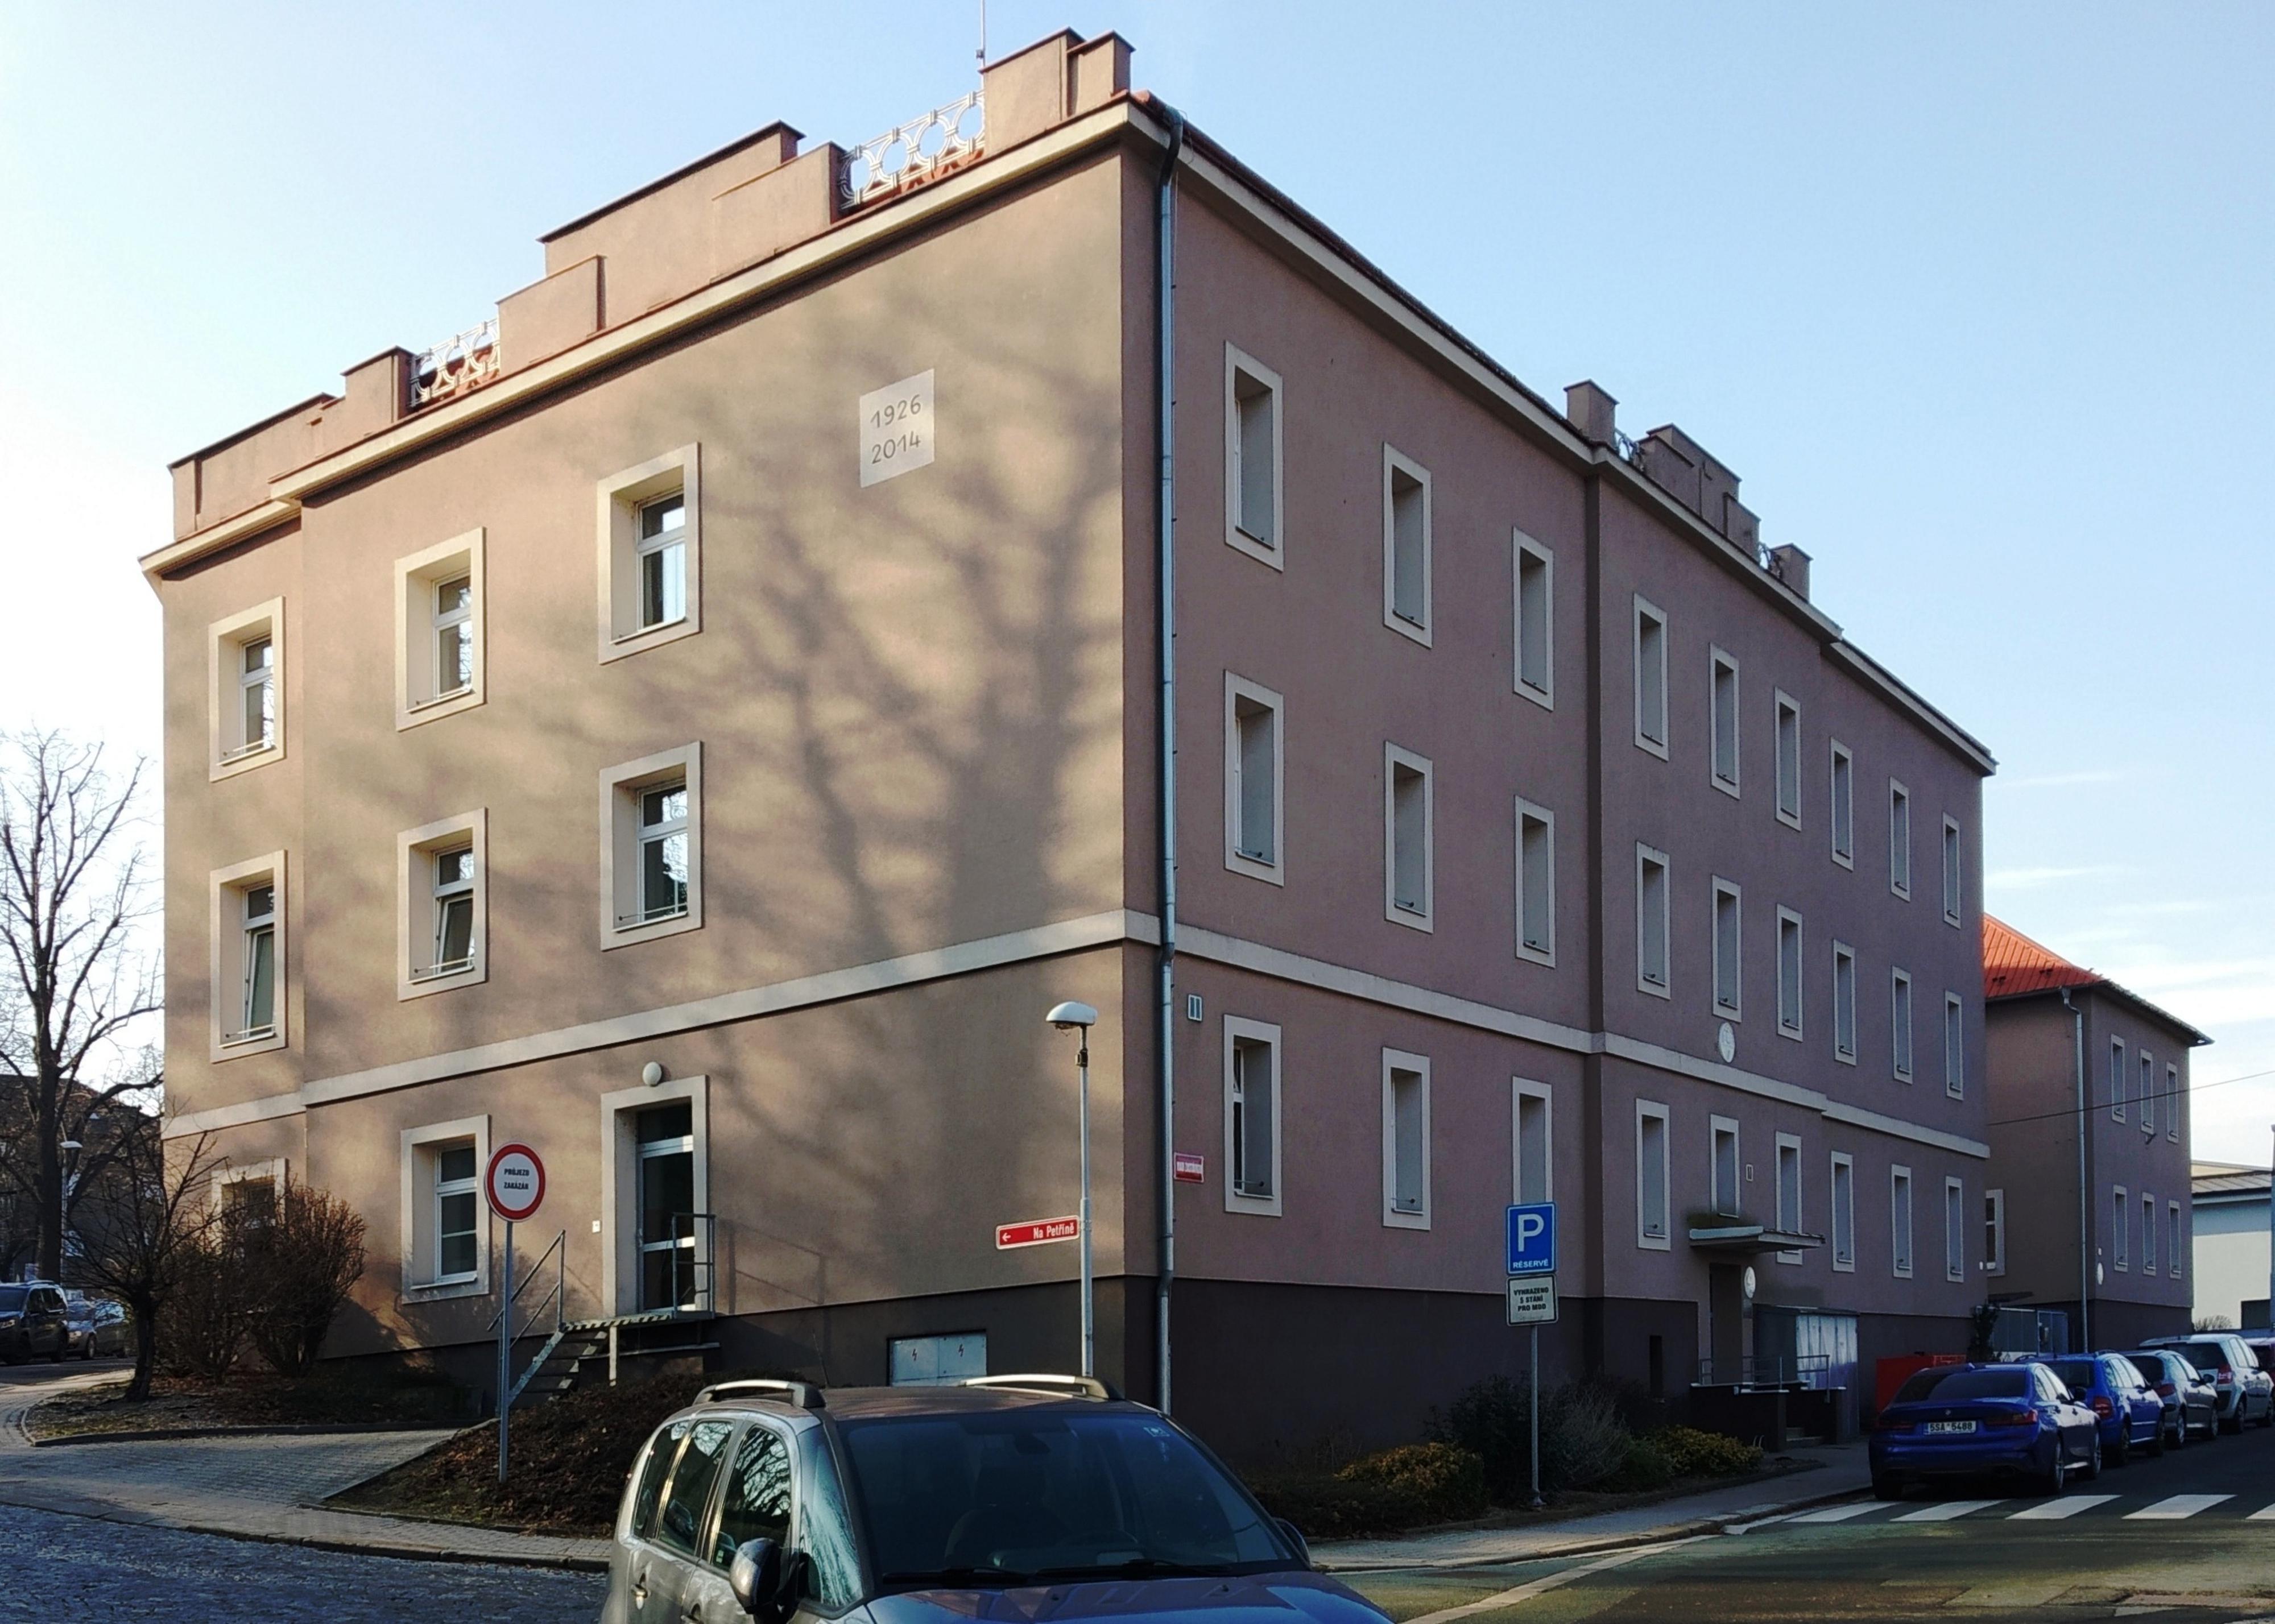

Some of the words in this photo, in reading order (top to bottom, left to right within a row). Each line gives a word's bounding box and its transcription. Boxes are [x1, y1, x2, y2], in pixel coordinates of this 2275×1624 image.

[870, 393, 921, 428] 1926
[871, 430, 921, 465] 2014
[1033, 1227, 1044, 1240] Na
[1517, 1213, 1544, 1252] P
[1513, 1258, 1548, 1269] RÉSERVÉ
